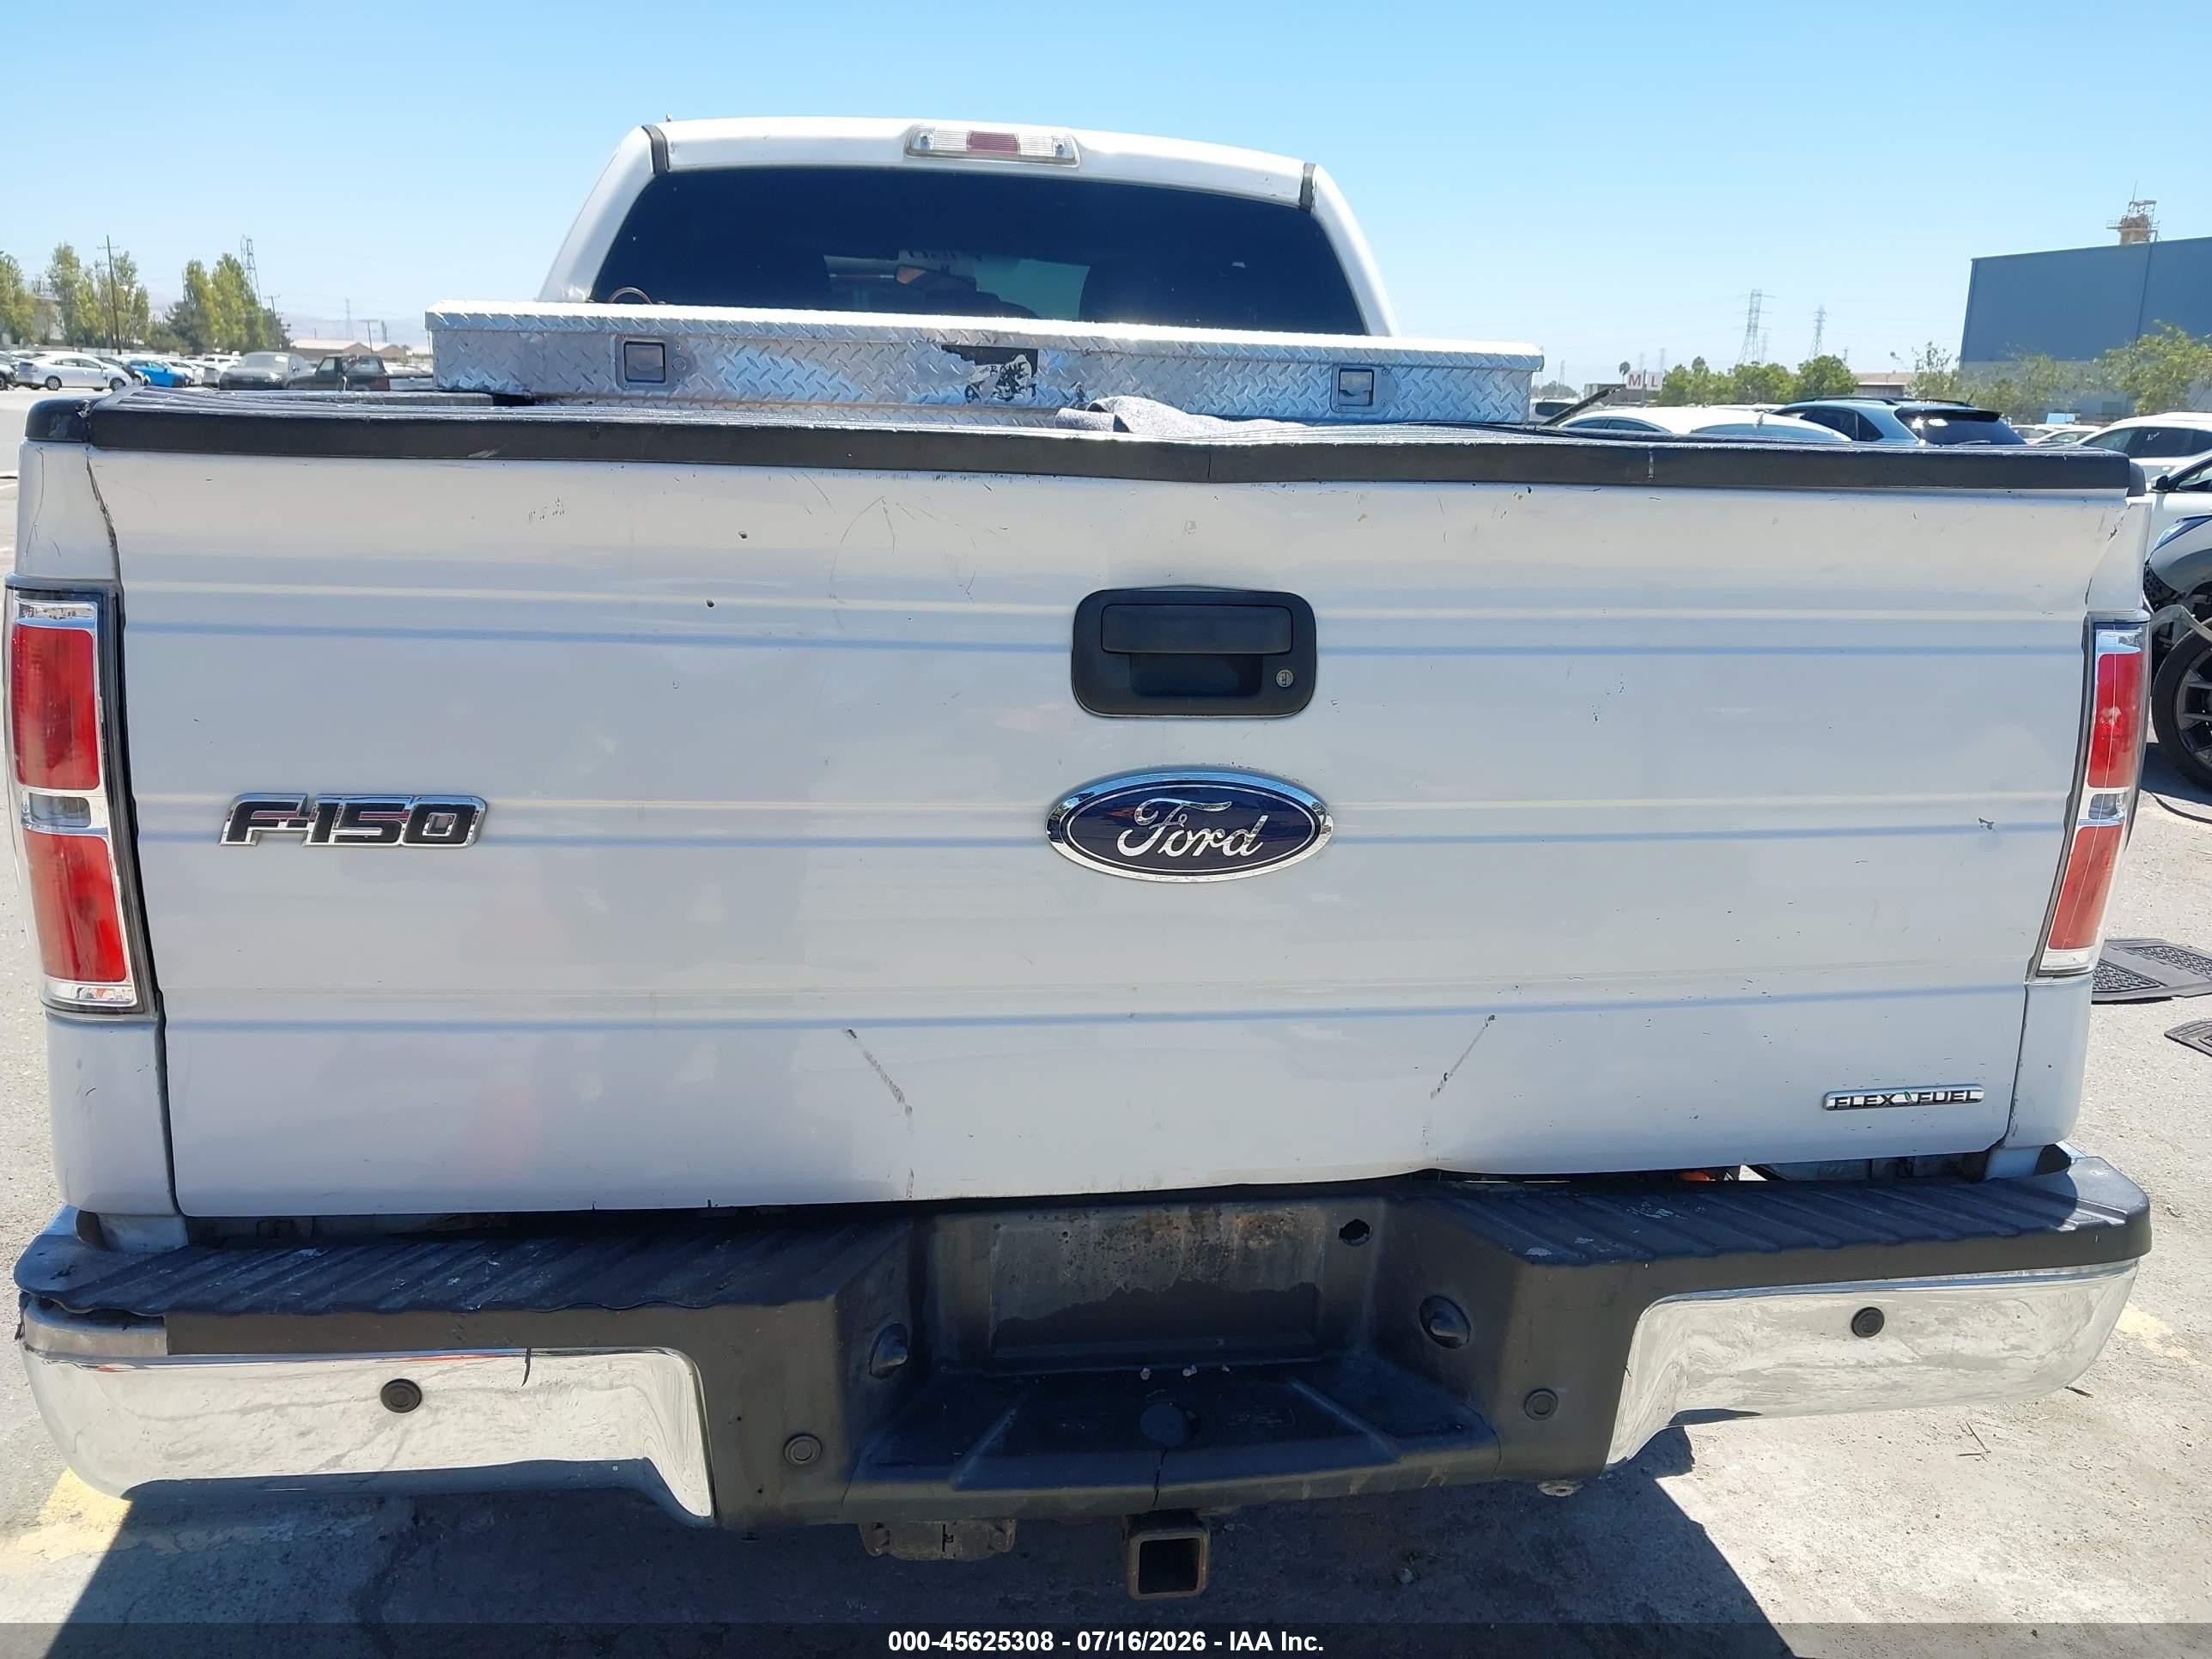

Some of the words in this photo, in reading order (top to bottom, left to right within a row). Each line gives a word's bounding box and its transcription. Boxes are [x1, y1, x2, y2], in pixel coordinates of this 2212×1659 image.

[220, 793, 488, 847] F-150
[1116, 797, 1269, 857] Ford
[1833, 1092, 1897, 1109] FLEX
[1916, 1089, 1980, 1105] FUEL
